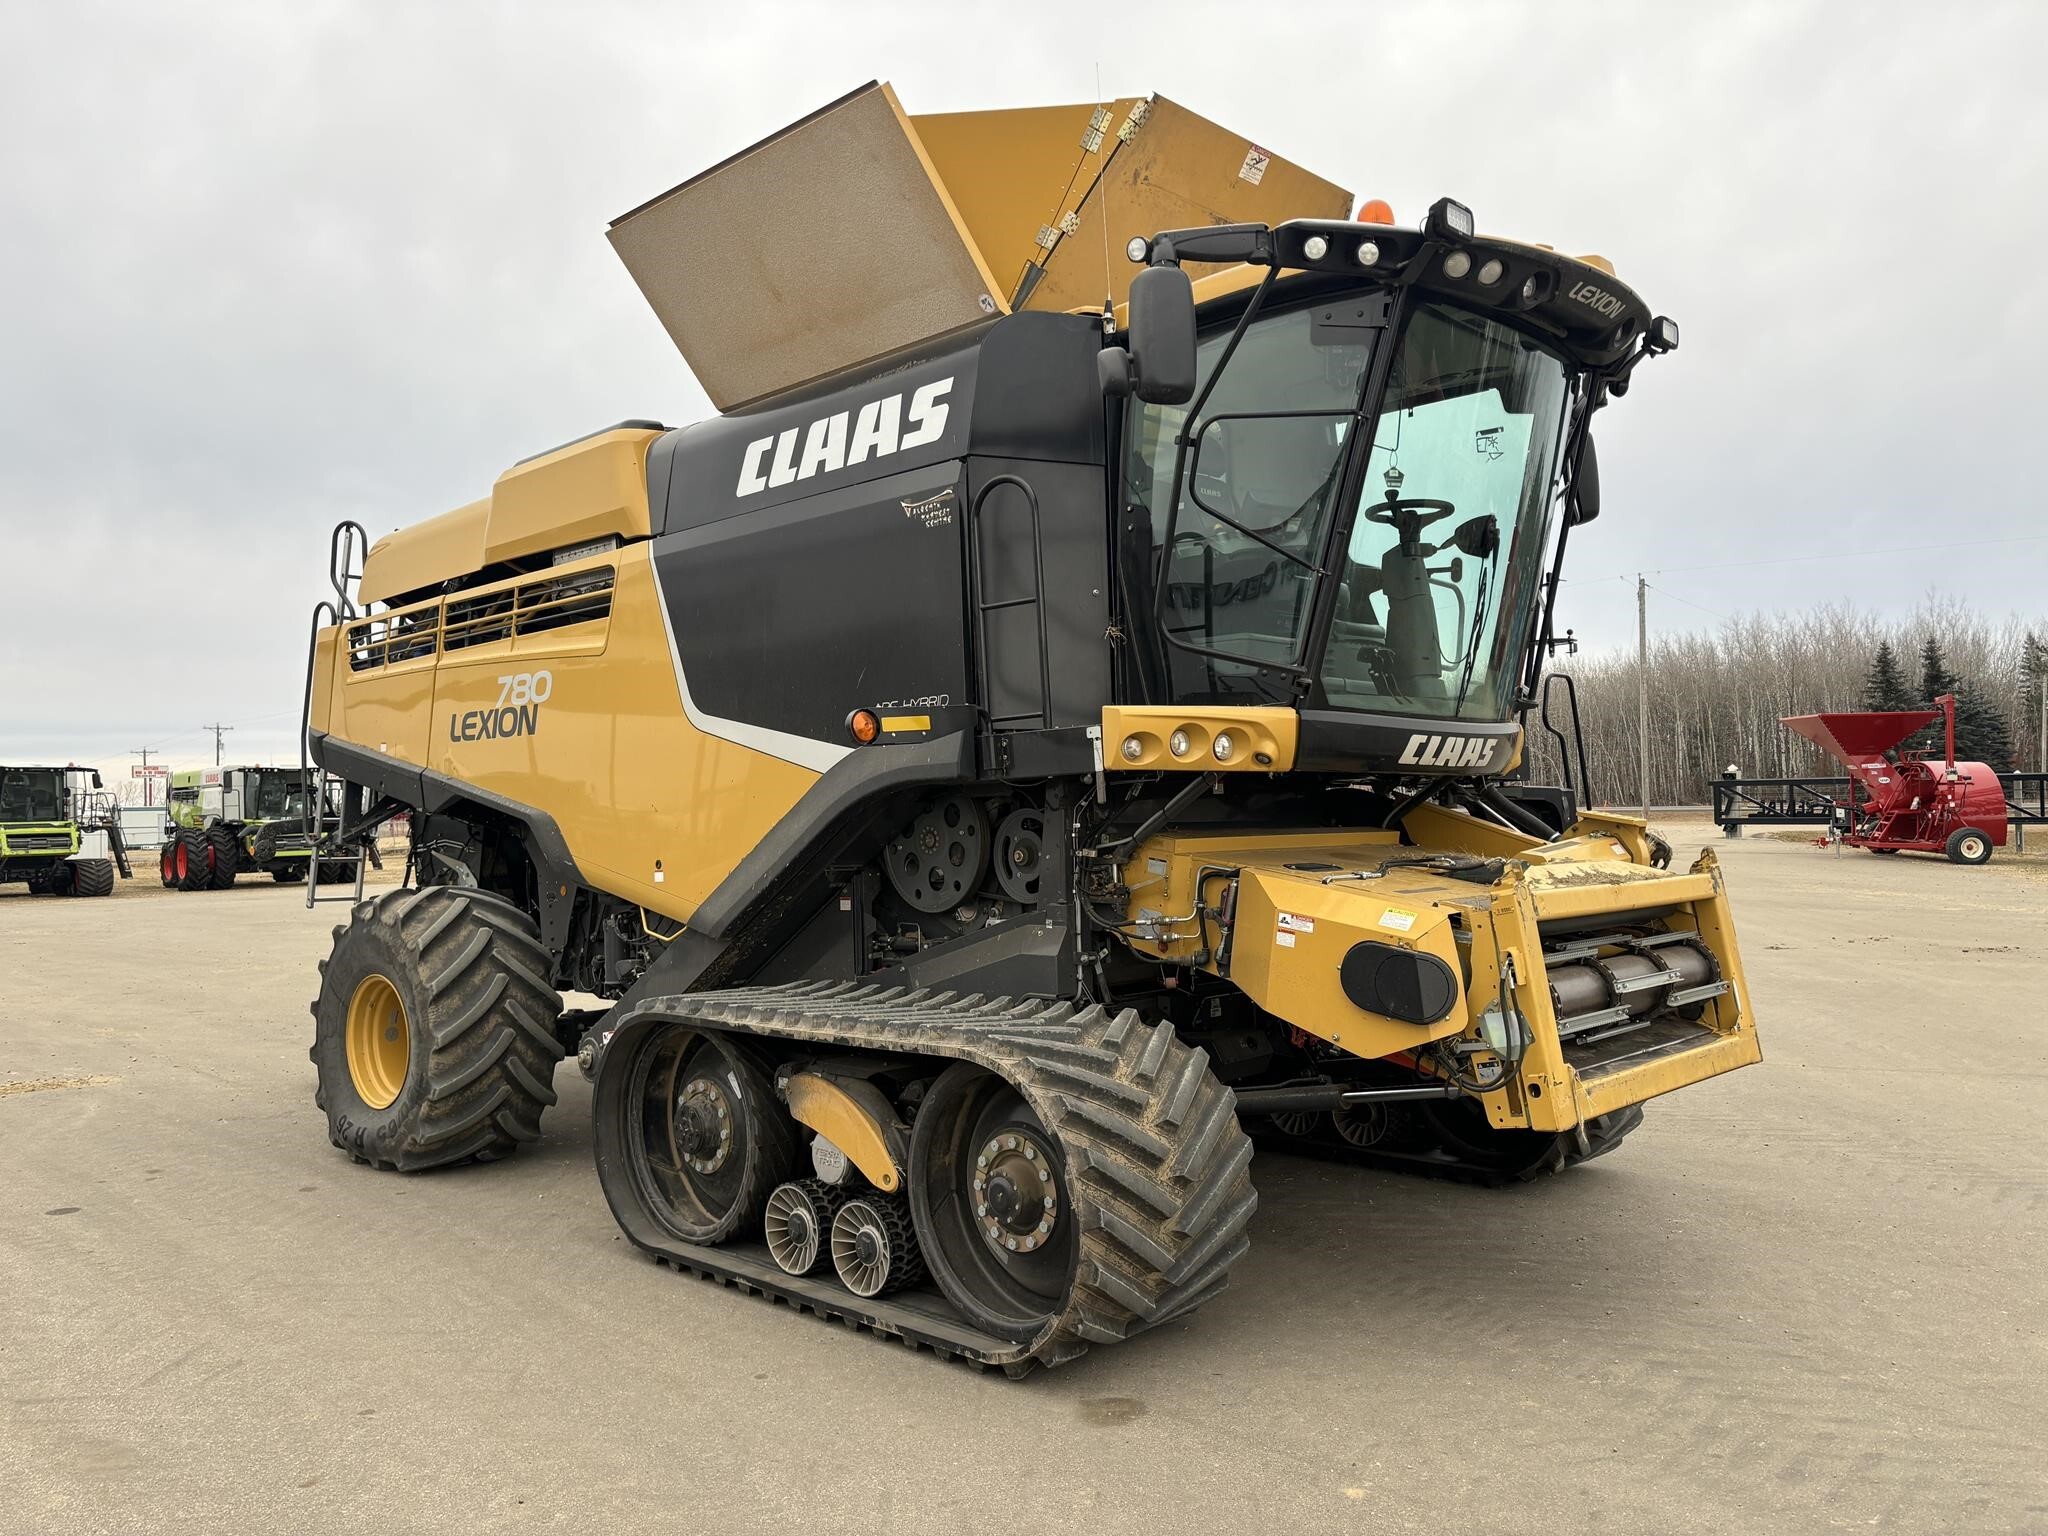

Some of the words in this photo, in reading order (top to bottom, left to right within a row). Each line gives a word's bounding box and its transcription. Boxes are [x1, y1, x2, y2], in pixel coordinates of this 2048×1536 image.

[1568, 281, 1626, 319] LEXION
[736, 376, 955, 498] CLAAS
[495, 669, 553, 708] 780
[450, 703, 539, 743] LEXION
[1397, 734, 1498, 767] CLAAS
